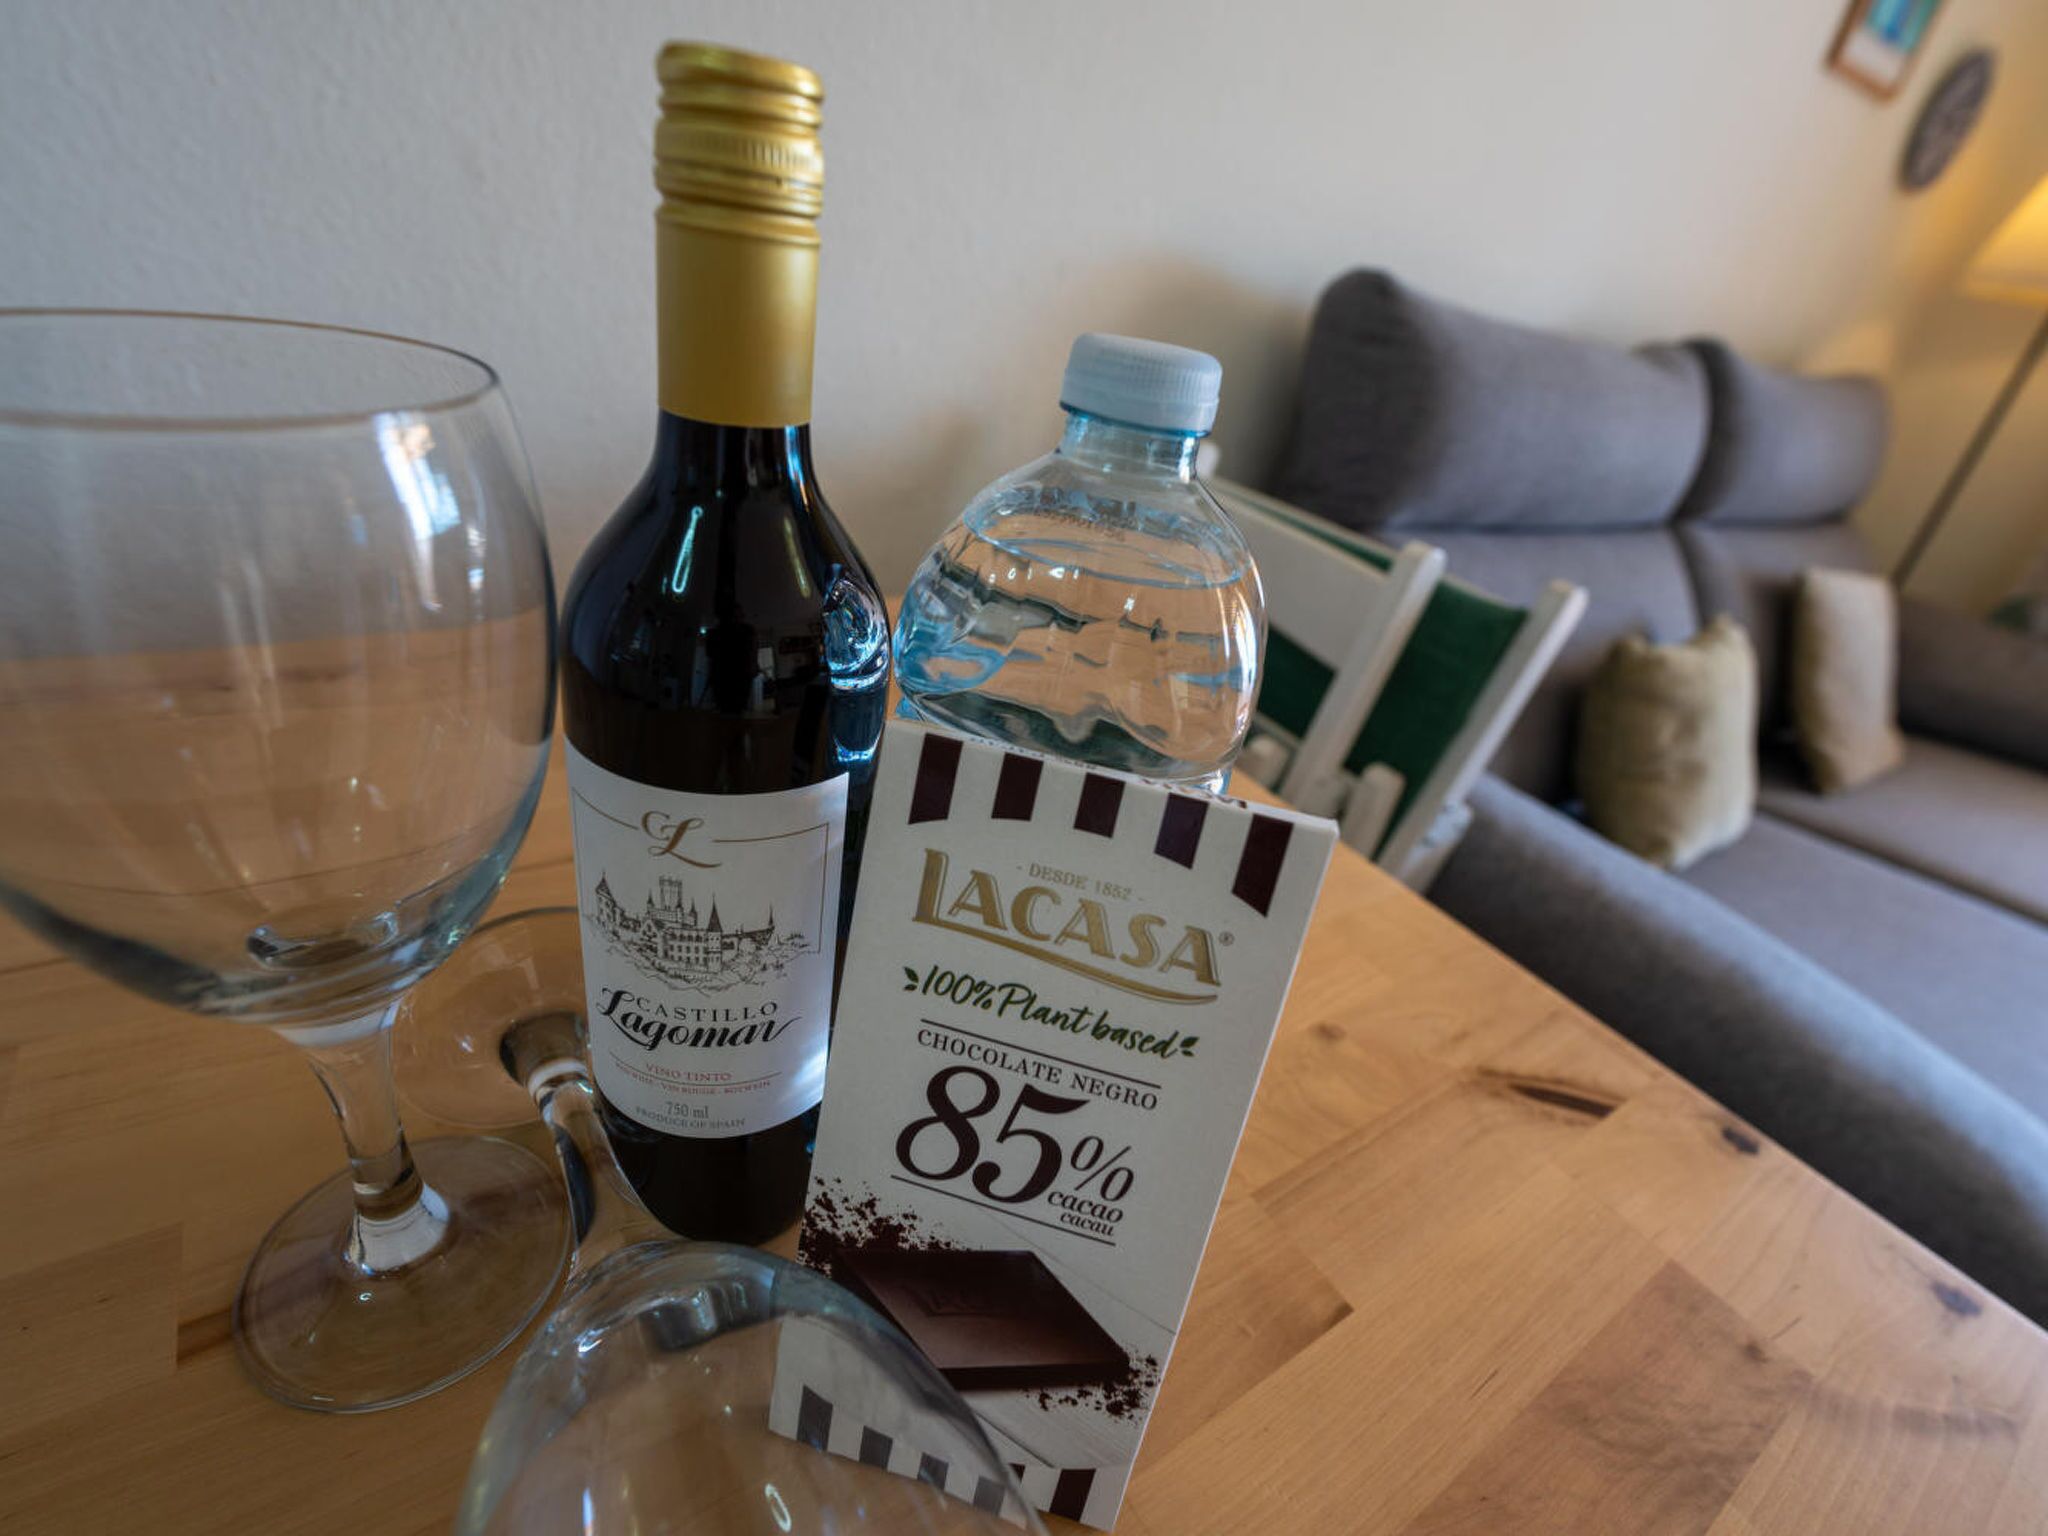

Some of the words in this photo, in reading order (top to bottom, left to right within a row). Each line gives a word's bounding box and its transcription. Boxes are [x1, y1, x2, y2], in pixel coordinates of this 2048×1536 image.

[1028, 863, 1088, 889] DESDE
[1095, 881, 1132, 901] 1852
[911, 847, 1222, 988] LACASA
[597, 987, 803, 1051] Lagomar
[636, 996, 779, 1022] CASTILLO
[922, 965, 996, 1010] 100%
[997, 983, 1089, 1034] Plant
[1091, 1009, 1180, 1060] based
[645, 1062, 682, 1079] VINO
[682, 1070, 732, 1081] TINTO
[918, 1029, 1063, 1084] CHOCOLATE
[1069, 1072, 1158, 1111] NEGRO
[665, 1100, 689, 1118] 750
[692, 1105, 709, 1119] ml
[895, 1065, 1135, 1204] 85%
[1047, 1190, 1124, 1224] cacao
[1059, 1212, 1115, 1238] cacau
